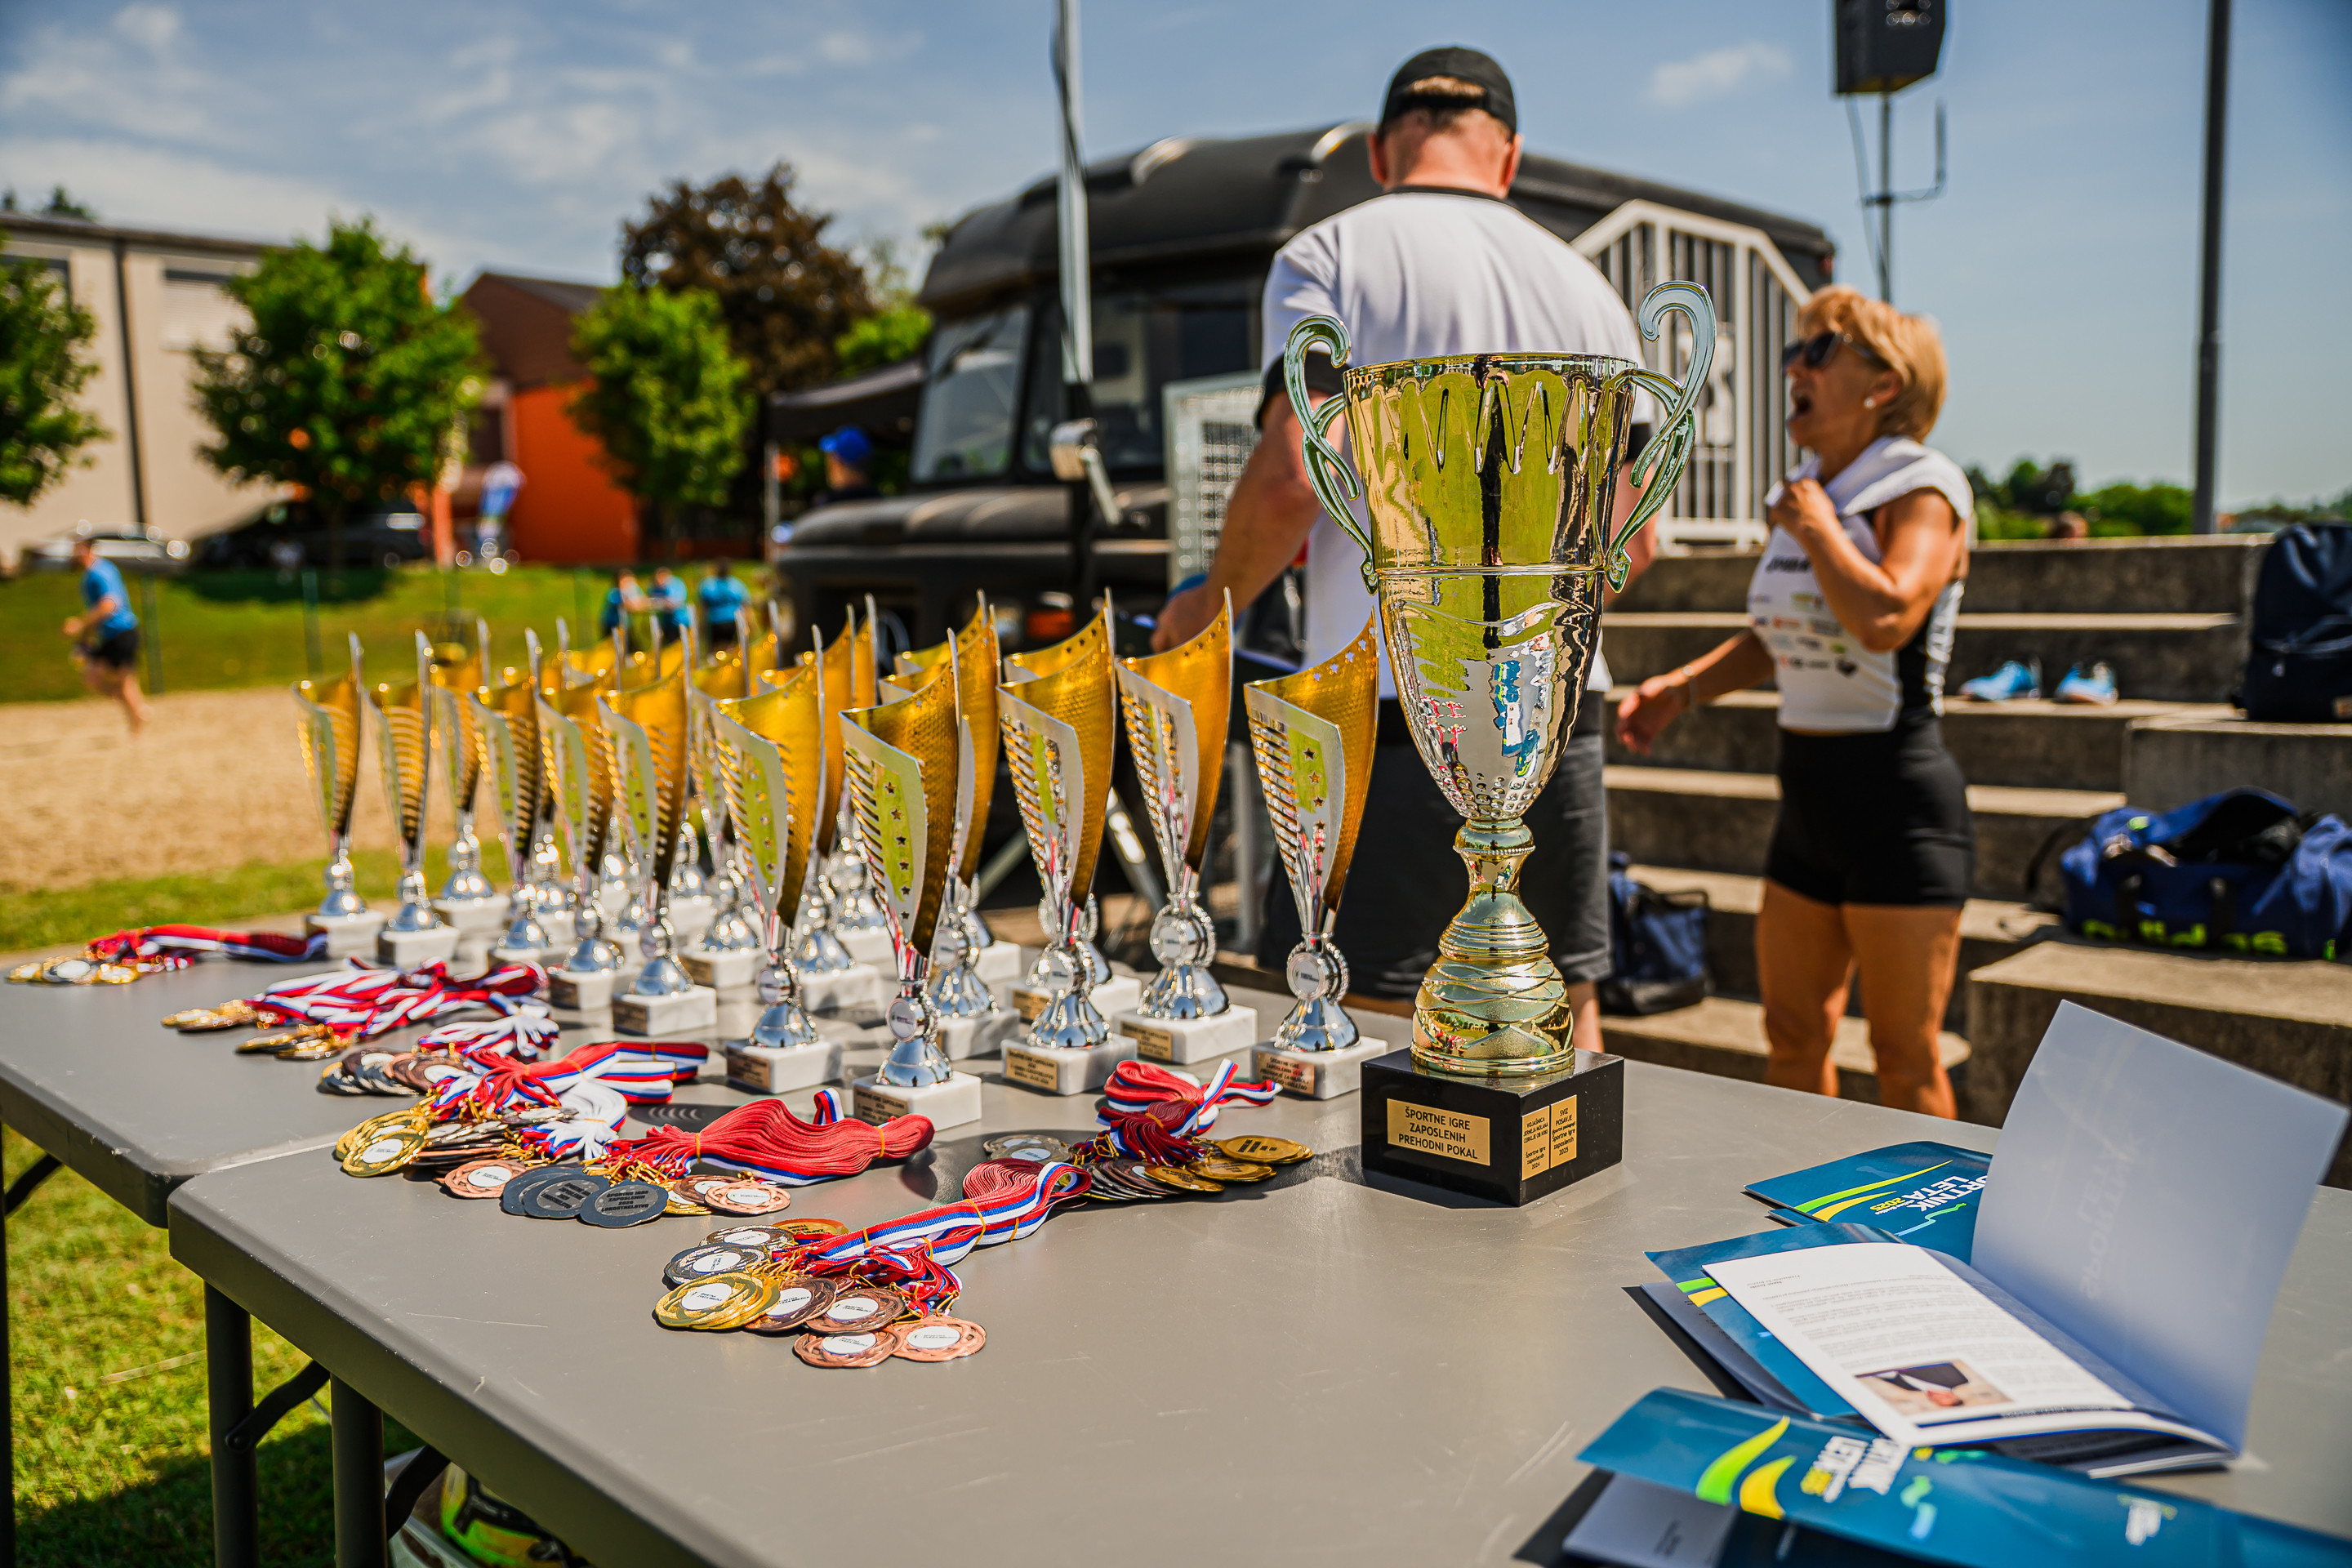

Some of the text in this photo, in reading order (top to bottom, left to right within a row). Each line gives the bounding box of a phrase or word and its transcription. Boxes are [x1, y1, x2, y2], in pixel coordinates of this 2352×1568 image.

[1405, 1105, 1471, 1130] ŠPORTNE IGRE
[1409, 1122, 1466, 1143] ZAPOSLENIH
[1398, 1133, 1478, 1160] PREHODNI POKAL
[1901, 1175, 1969, 1200] LETA
[1869, 1197, 1906, 1211] 2025
